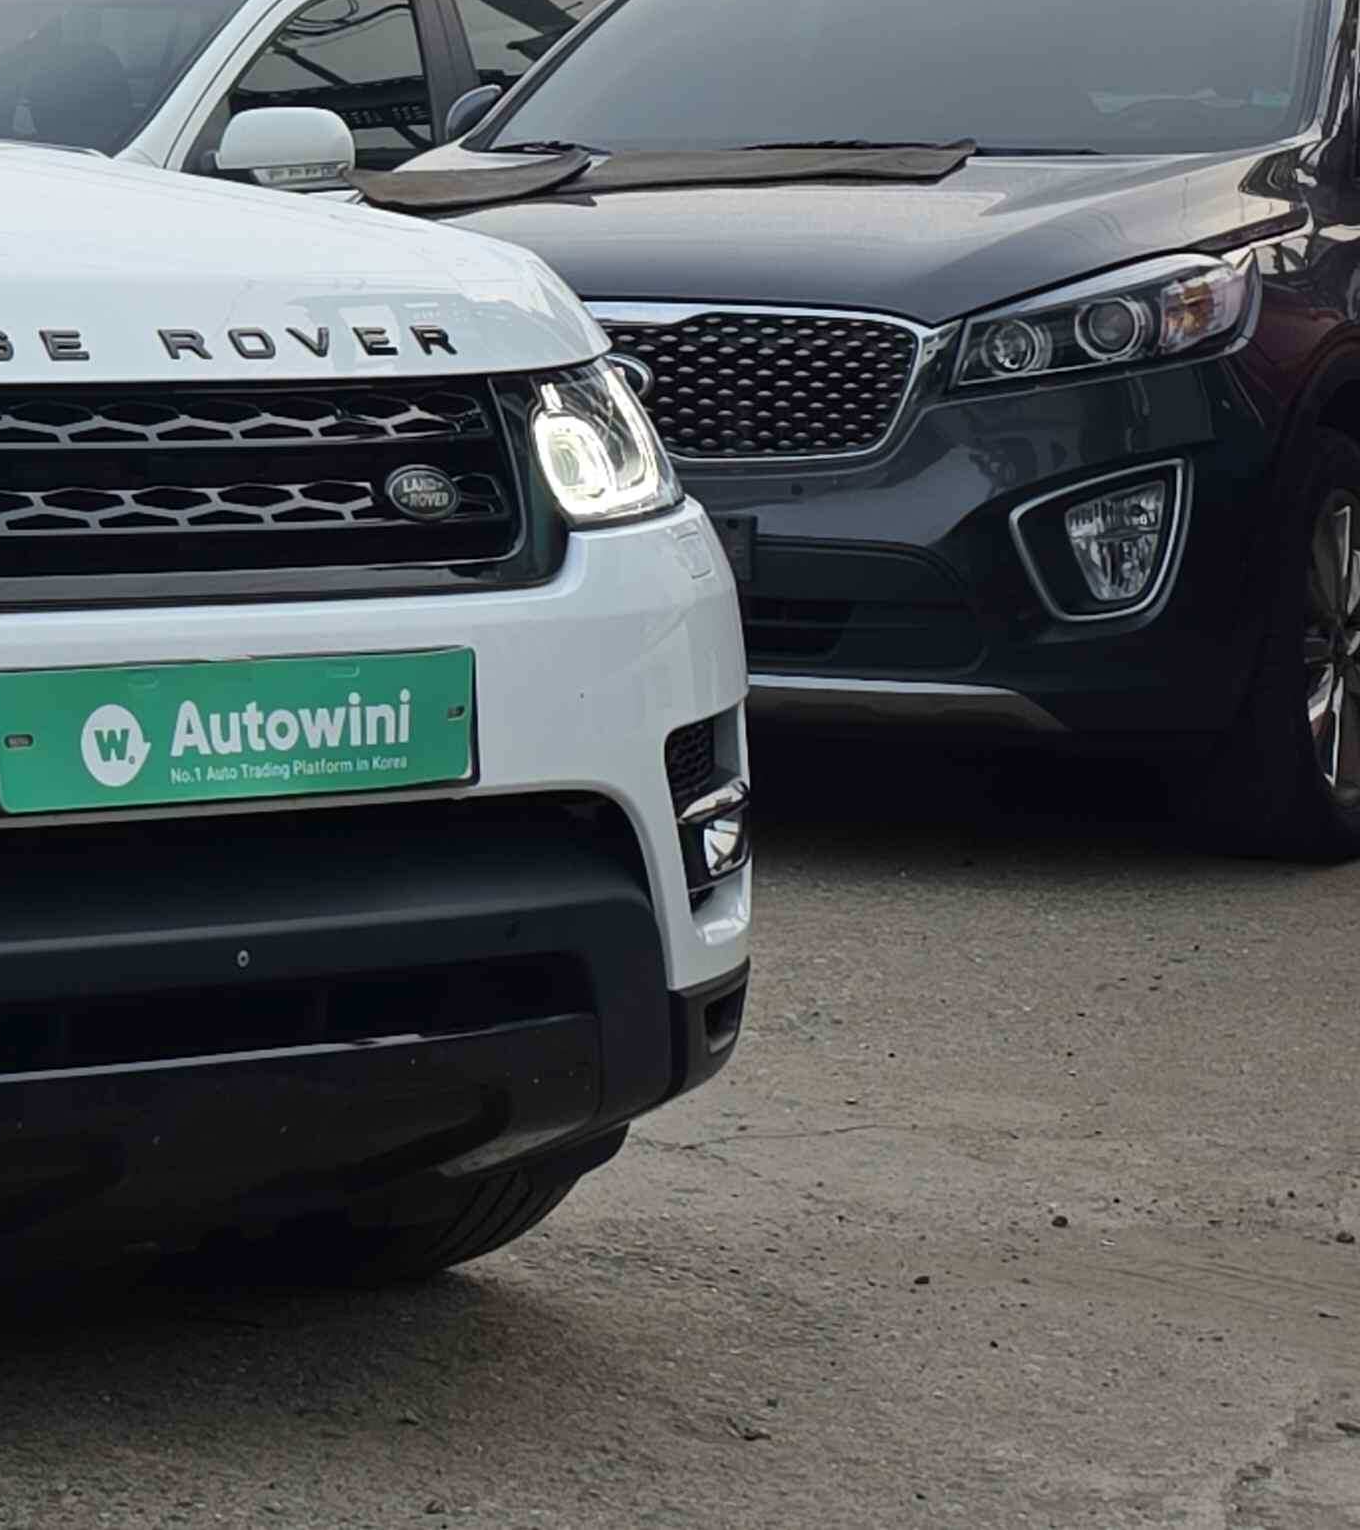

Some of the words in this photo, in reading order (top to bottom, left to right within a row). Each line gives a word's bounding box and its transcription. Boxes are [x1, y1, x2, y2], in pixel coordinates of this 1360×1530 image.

[157, 323, 459, 360] ROVER
[170, 688, 410, 757] Autowini
[170, 766, 203, 785] No.1
[206, 764, 238, 782] Auto
[240, 761, 291, 781] Trading
[292, 757, 353, 776] Platform
[356, 756, 369, 771] in
[371, 755, 408, 771] Korea
